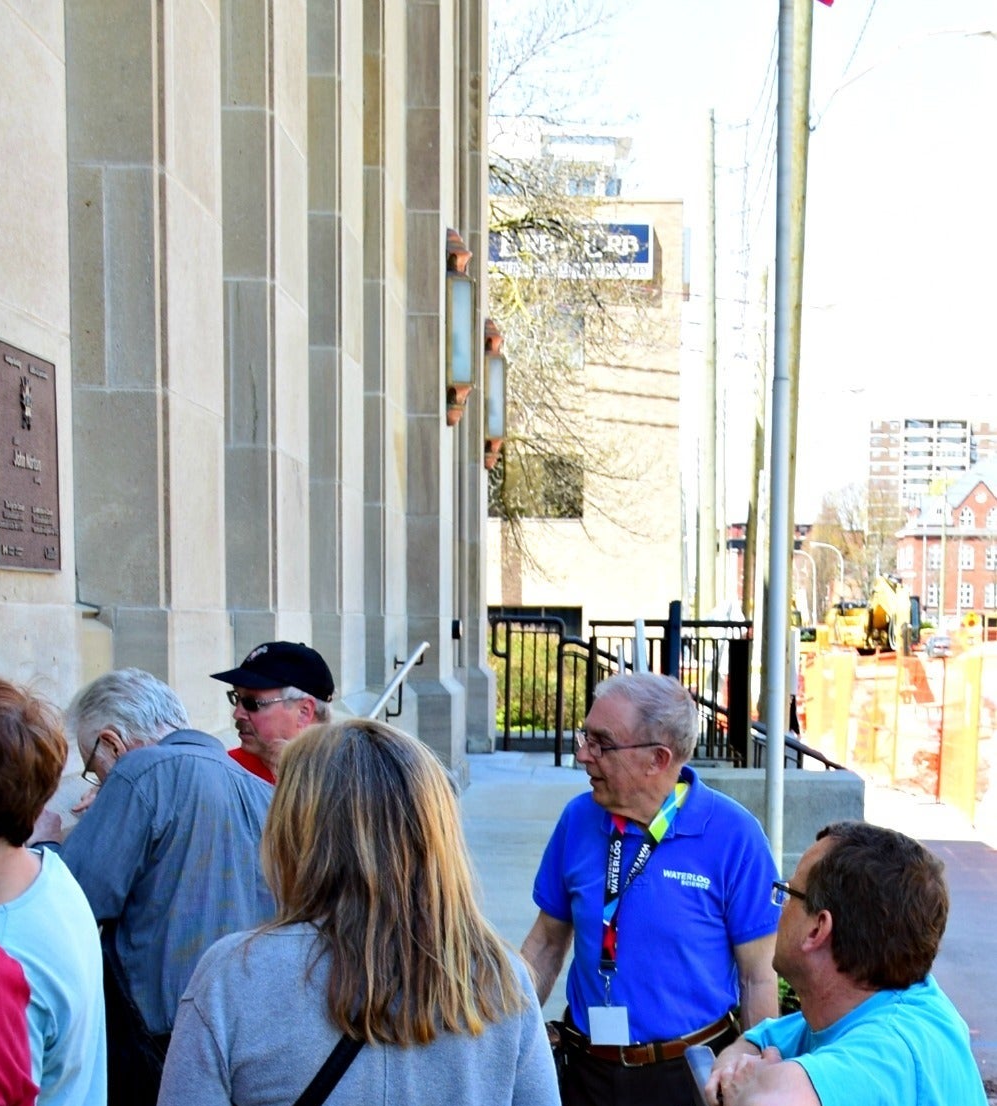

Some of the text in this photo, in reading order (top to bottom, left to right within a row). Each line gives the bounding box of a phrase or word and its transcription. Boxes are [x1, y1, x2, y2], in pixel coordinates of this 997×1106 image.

[610, 840, 622, 894] WATERLOO
[663, 869, 711, 884] WATERLOO
[681, 880, 710, 890] SCIENCE
